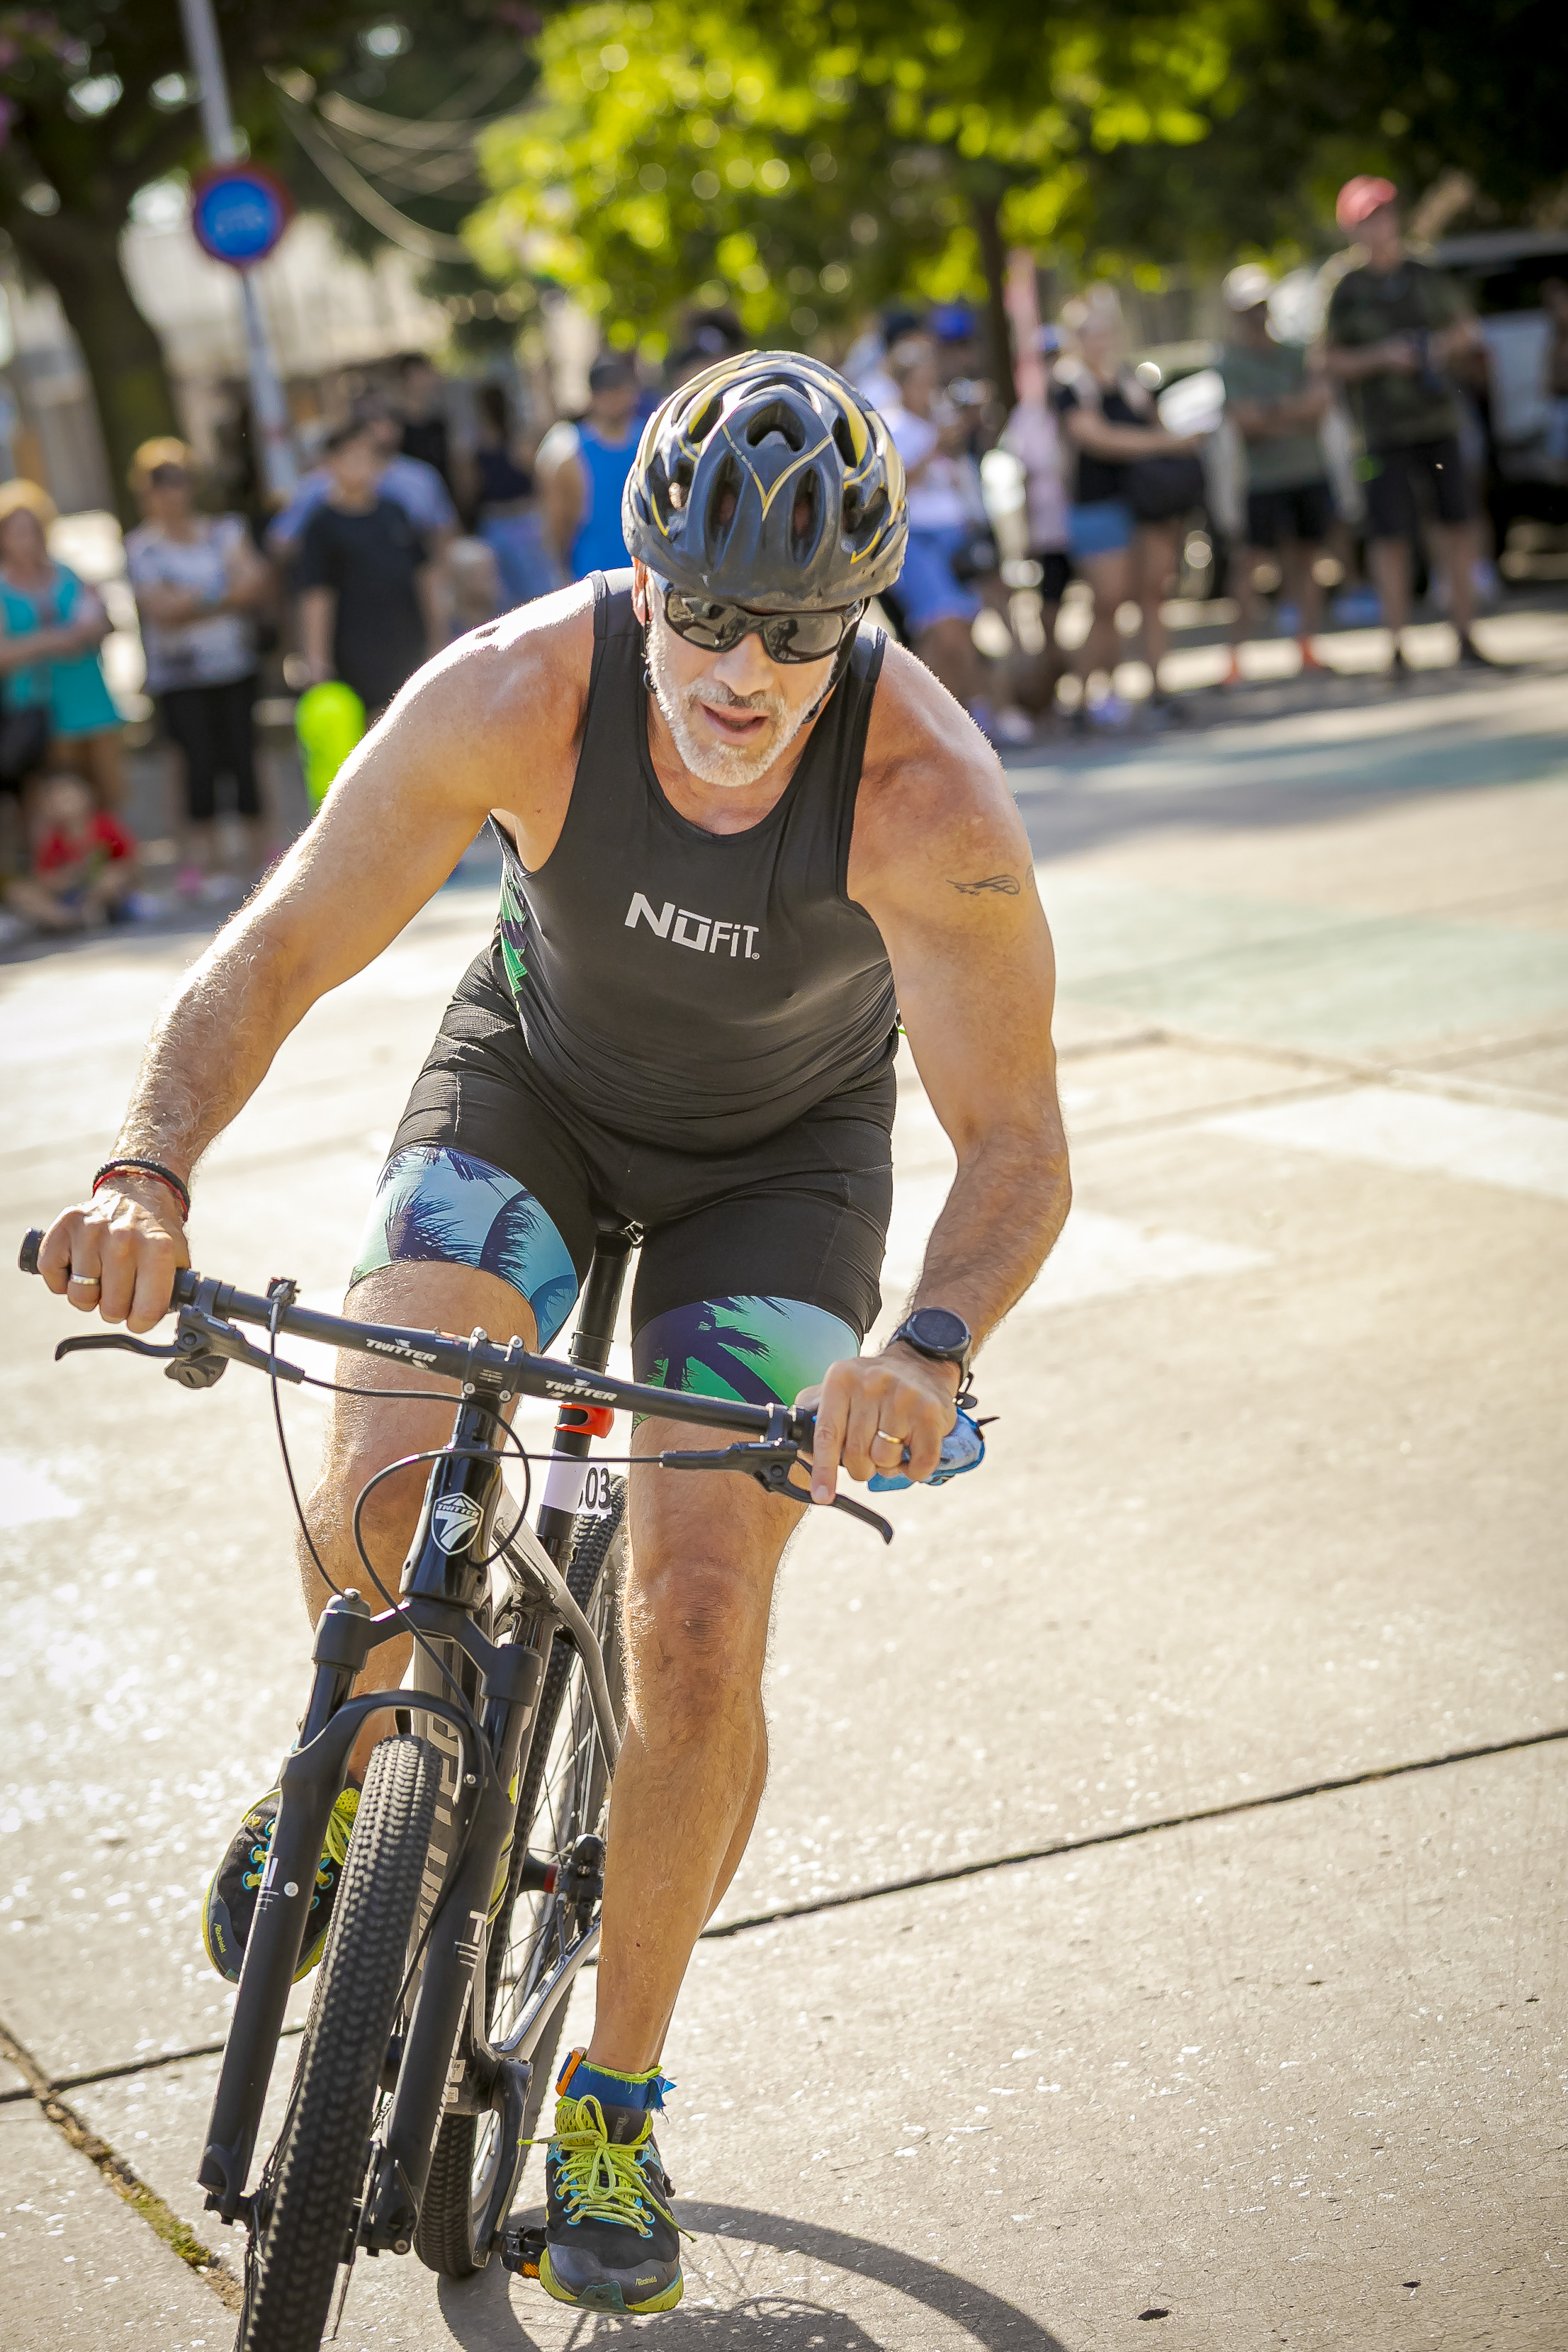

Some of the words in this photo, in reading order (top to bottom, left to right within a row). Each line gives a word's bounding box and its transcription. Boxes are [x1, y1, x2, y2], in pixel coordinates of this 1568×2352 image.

[366, 1338, 437, 1363] TWITTER
[545, 1380, 618, 1401] TWITTER
[577, 1467, 612, 1510] 03
